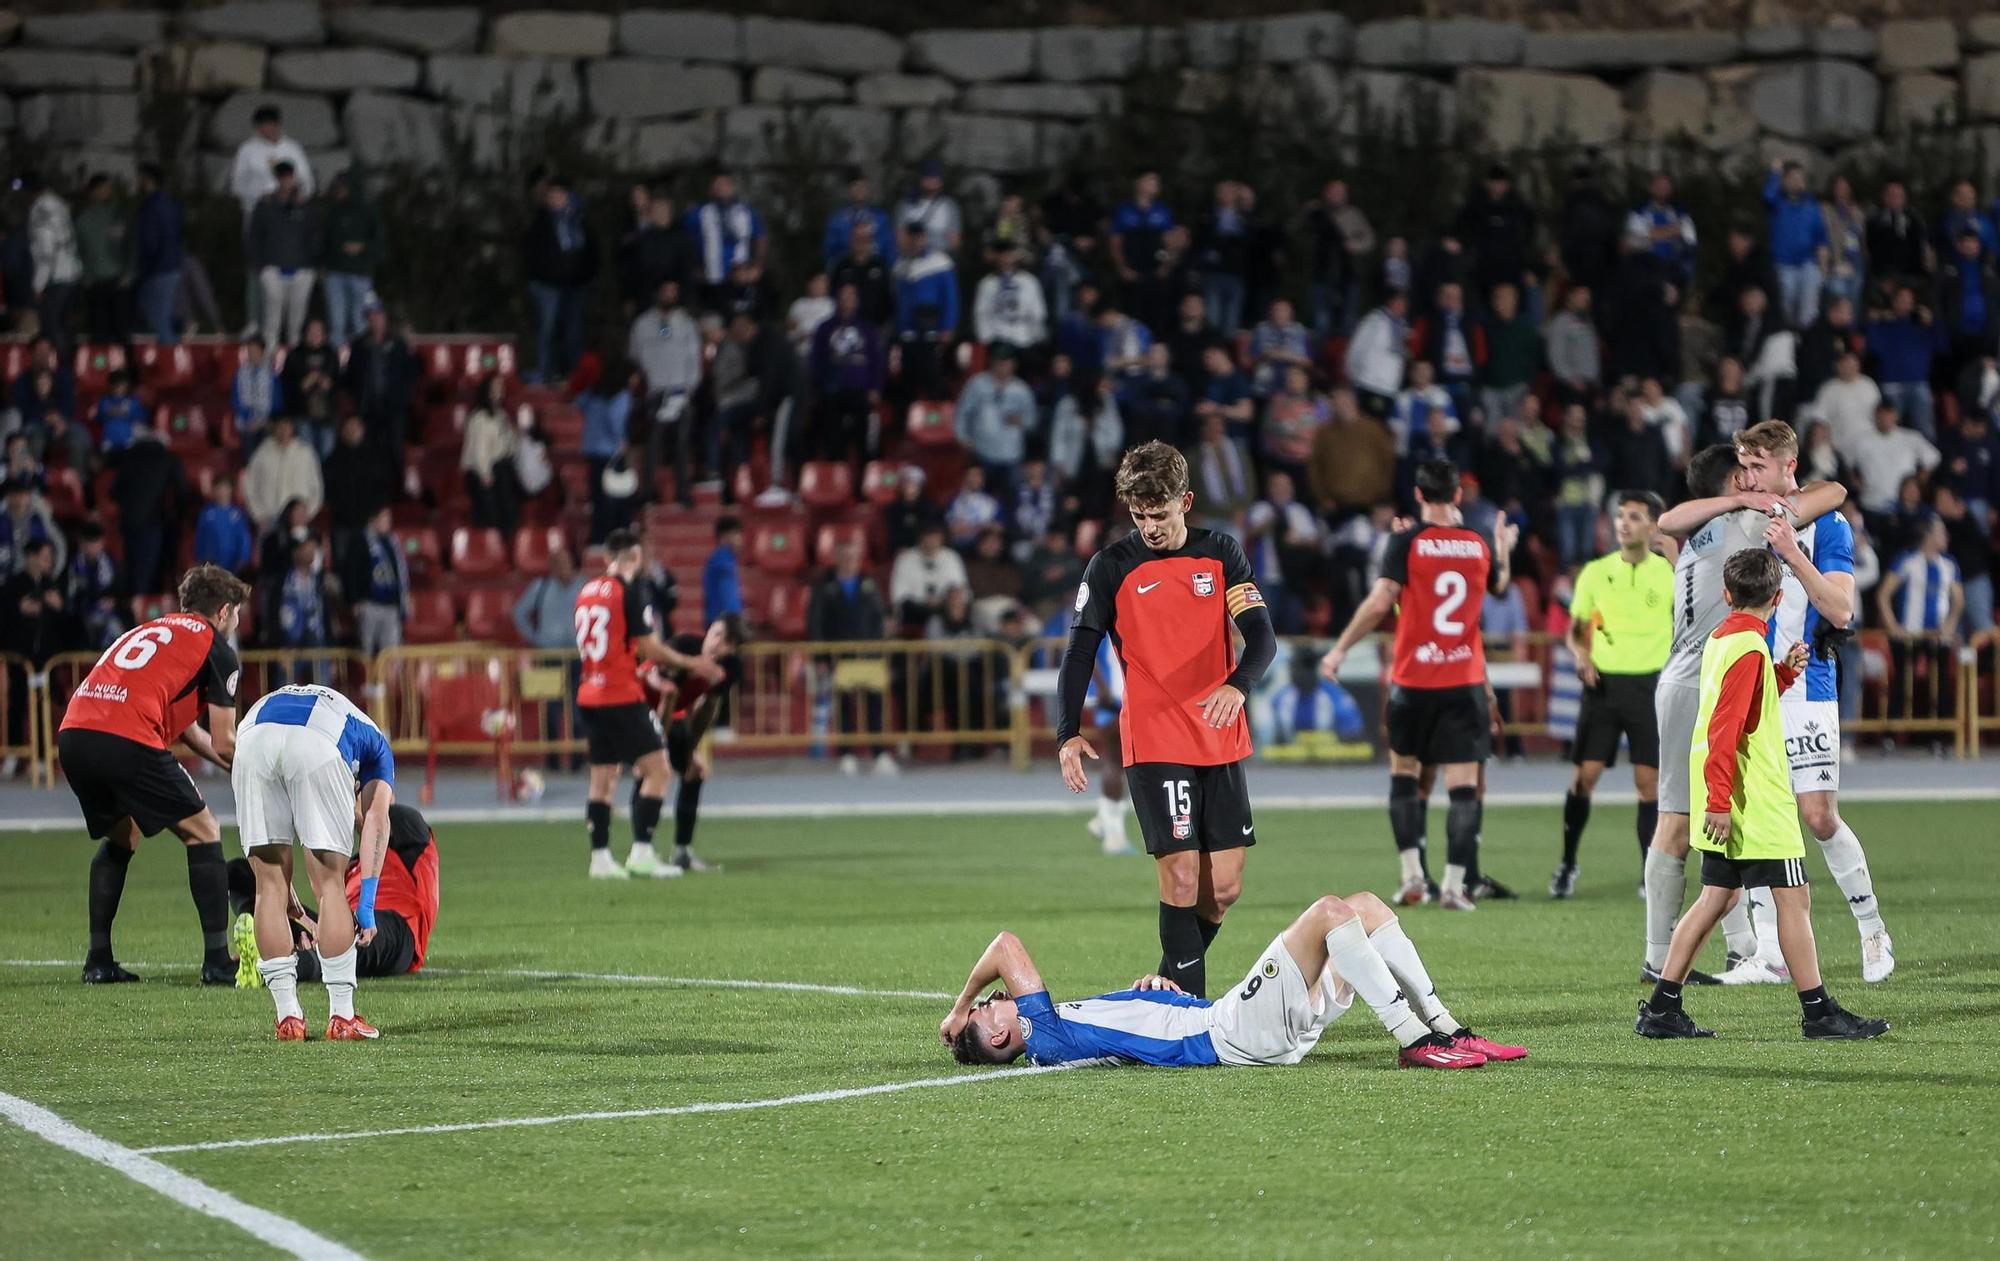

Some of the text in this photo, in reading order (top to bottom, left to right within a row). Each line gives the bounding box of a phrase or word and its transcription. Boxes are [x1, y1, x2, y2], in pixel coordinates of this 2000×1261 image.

[1434, 570, 1467, 636] 2
[575, 605, 611, 662] 23
[94, 683, 128, 698] NUCIA
[1785, 733, 1831, 757] CRC
[1162, 780, 1191, 816] 15
